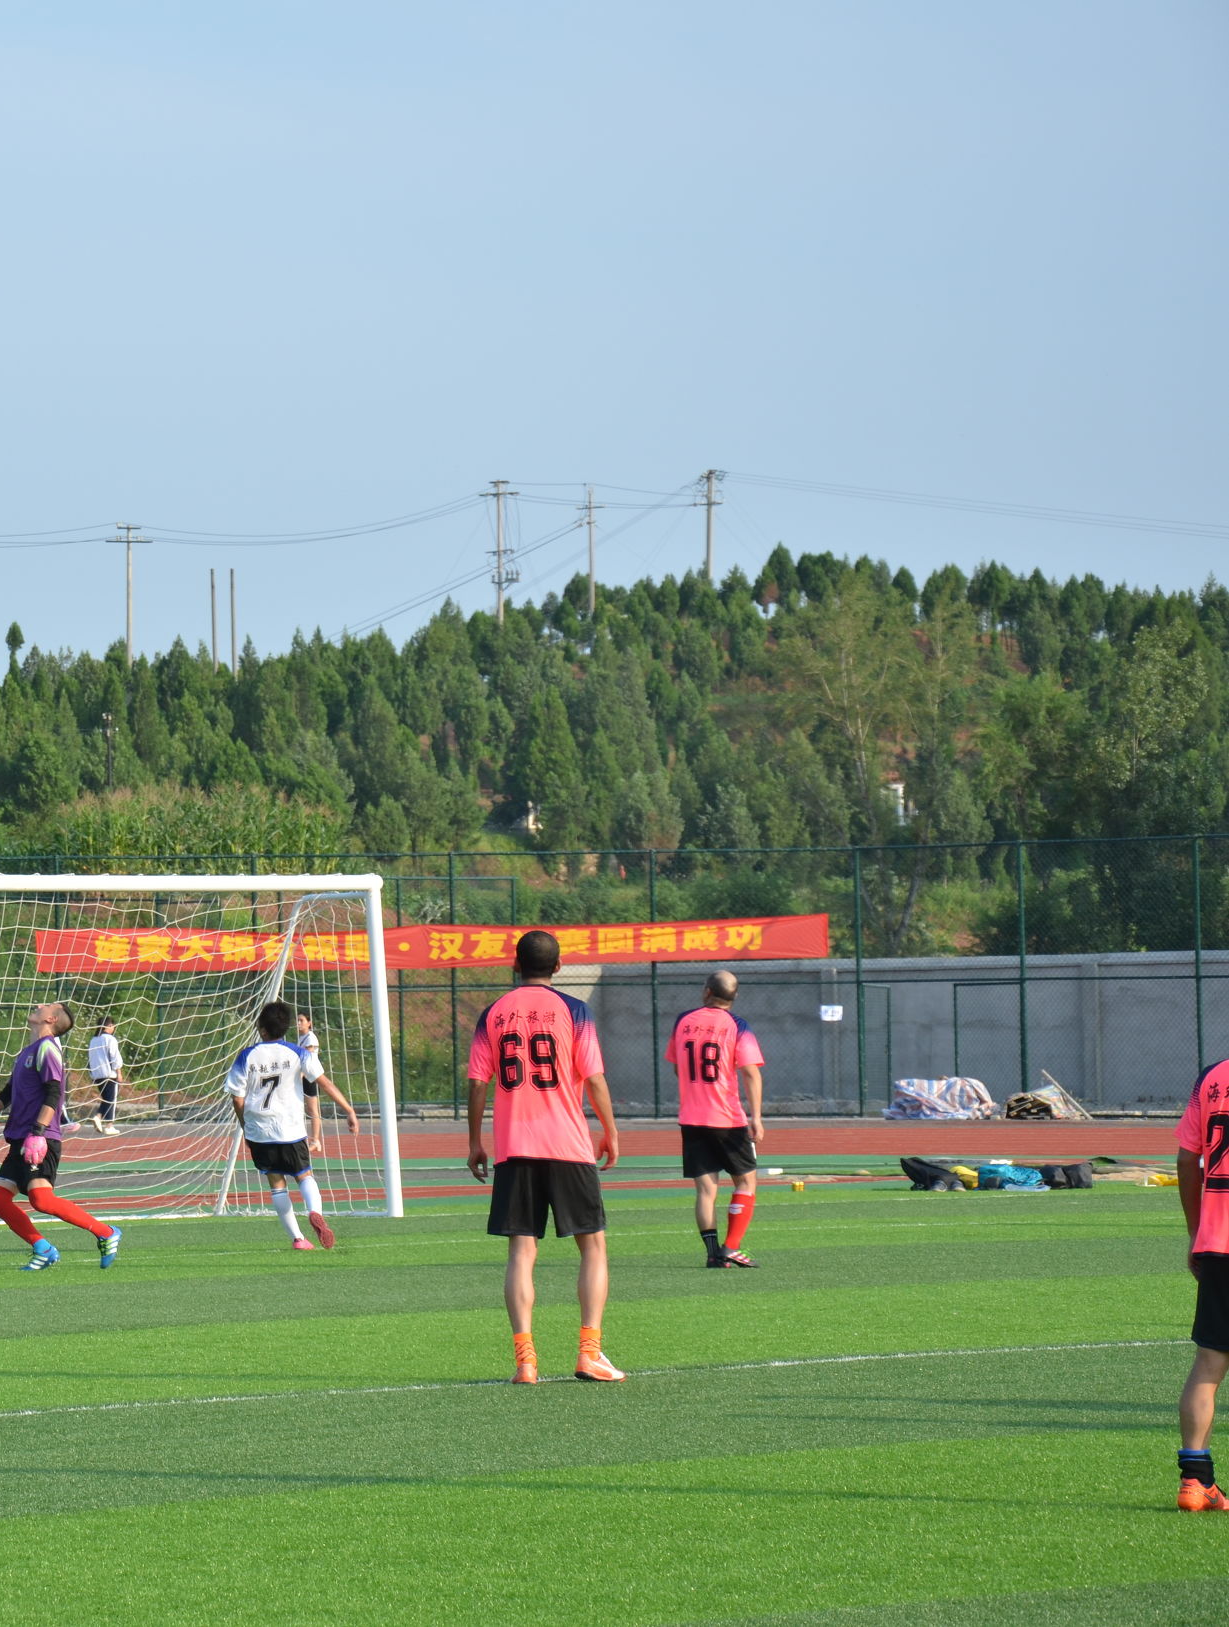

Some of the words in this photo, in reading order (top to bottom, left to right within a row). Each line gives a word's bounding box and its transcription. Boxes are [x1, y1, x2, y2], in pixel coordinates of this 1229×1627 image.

[498, 1031, 561, 1093] 69
[684, 1040, 721, 1083] 18
[260, 1074, 282, 1111] 7
